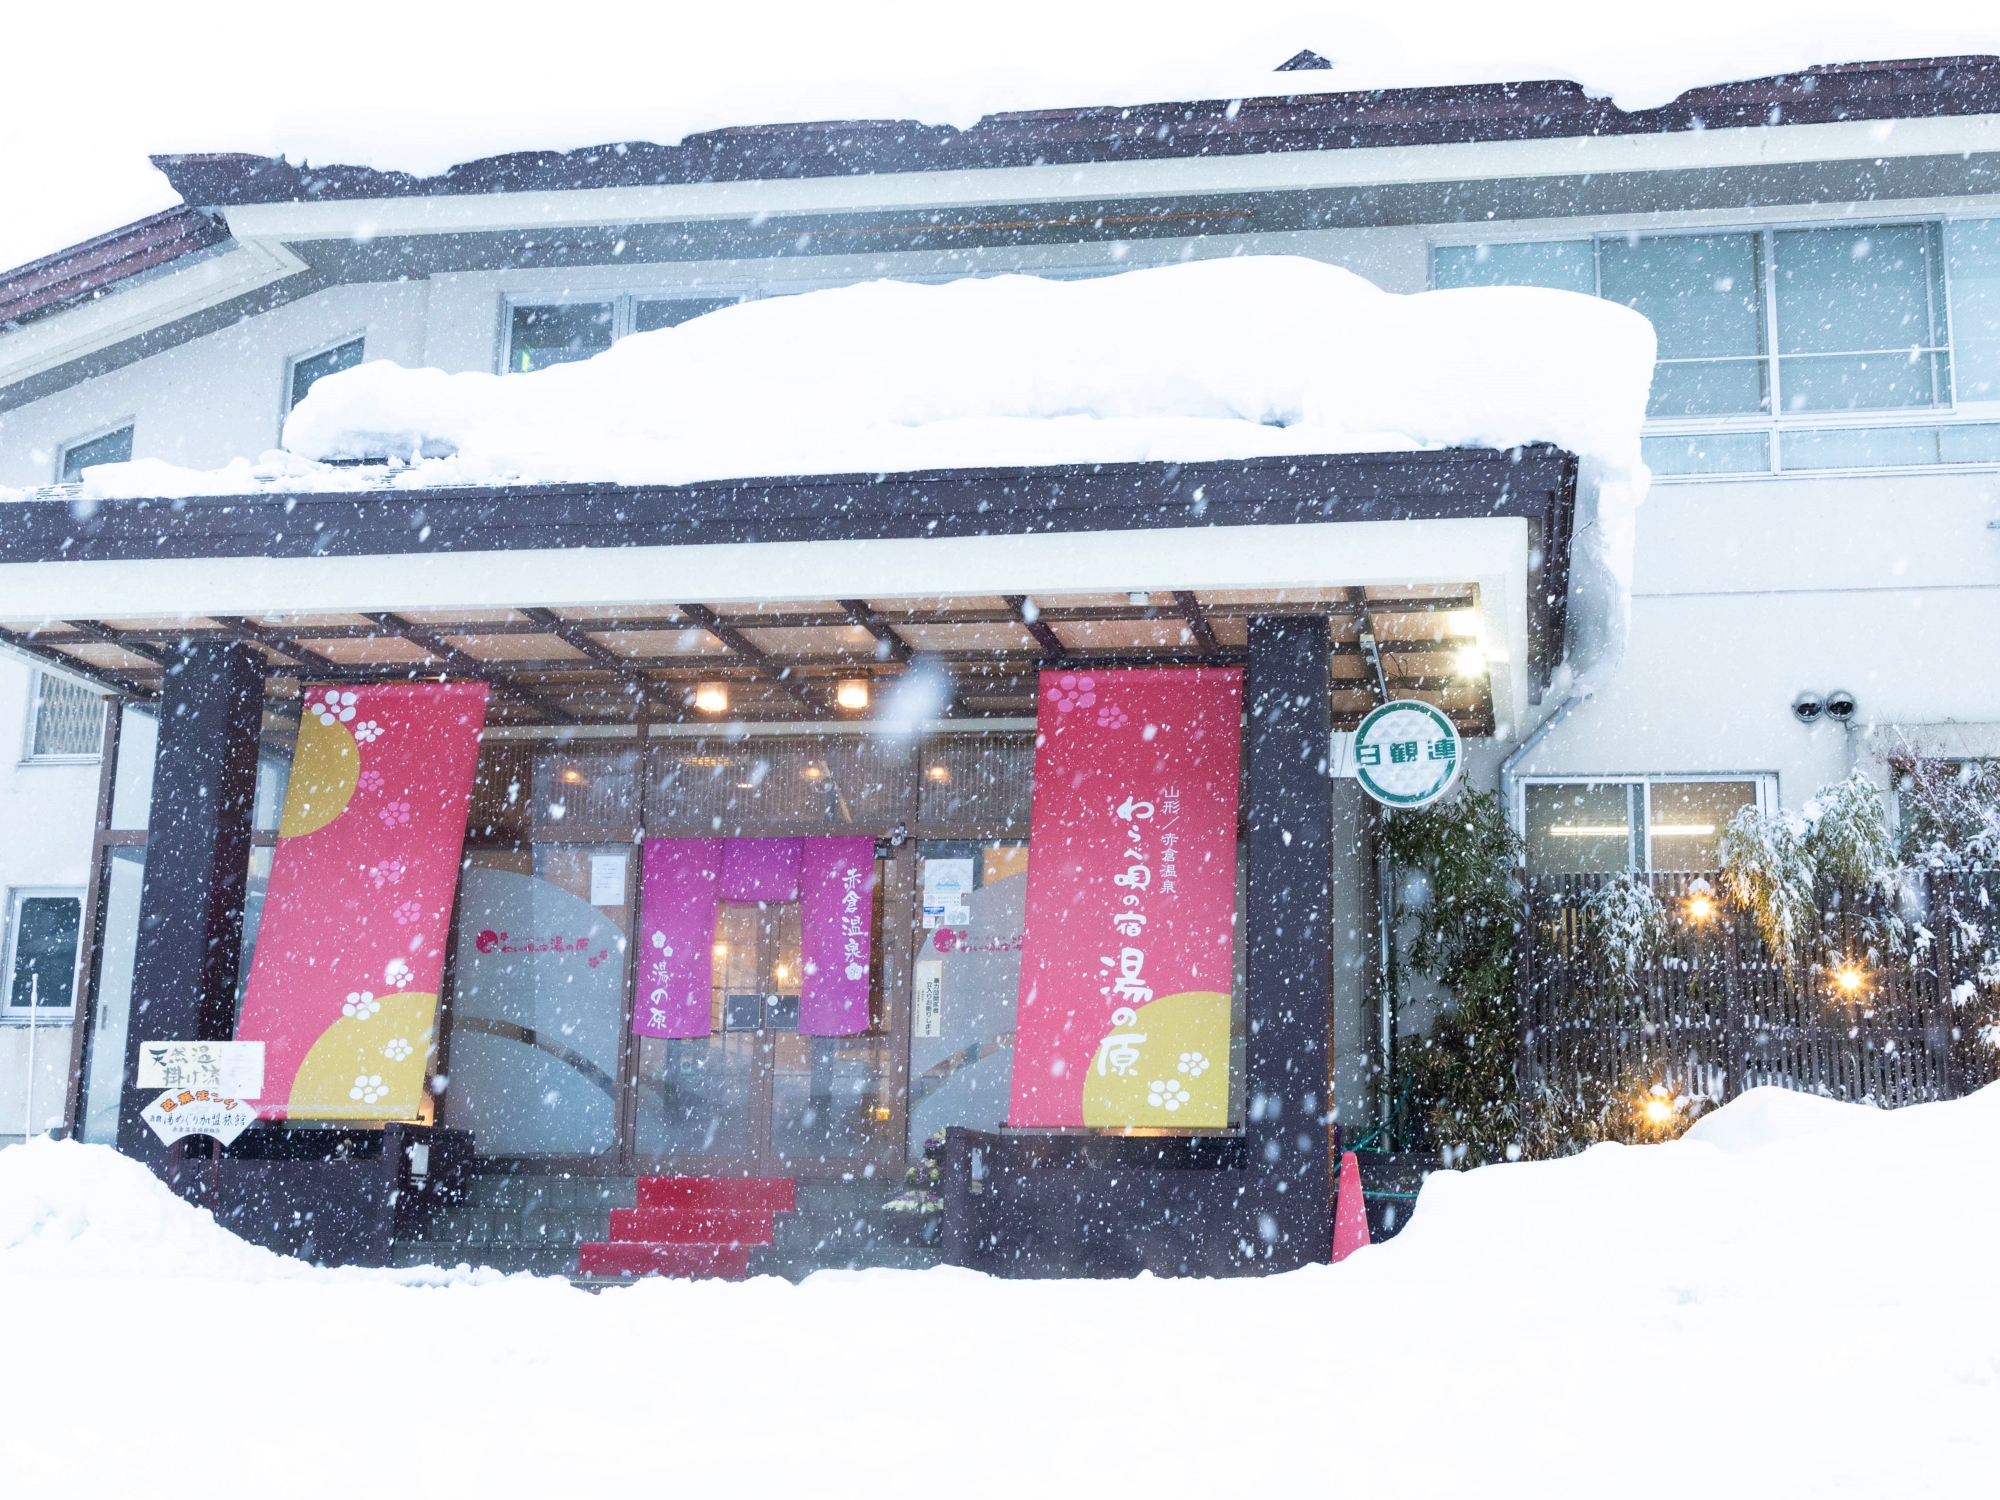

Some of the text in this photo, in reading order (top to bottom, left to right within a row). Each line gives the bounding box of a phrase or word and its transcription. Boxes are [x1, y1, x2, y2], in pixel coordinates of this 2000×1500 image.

[1355, 738, 1456, 766] 日観連
[841, 867, 864, 962] 赤倉温泉
[1097, 795, 1155, 1077] わらべ唄の宿 湯の原
[647, 961, 671, 1030] 湯の原
[148, 1045, 222, 1067] 天然温
